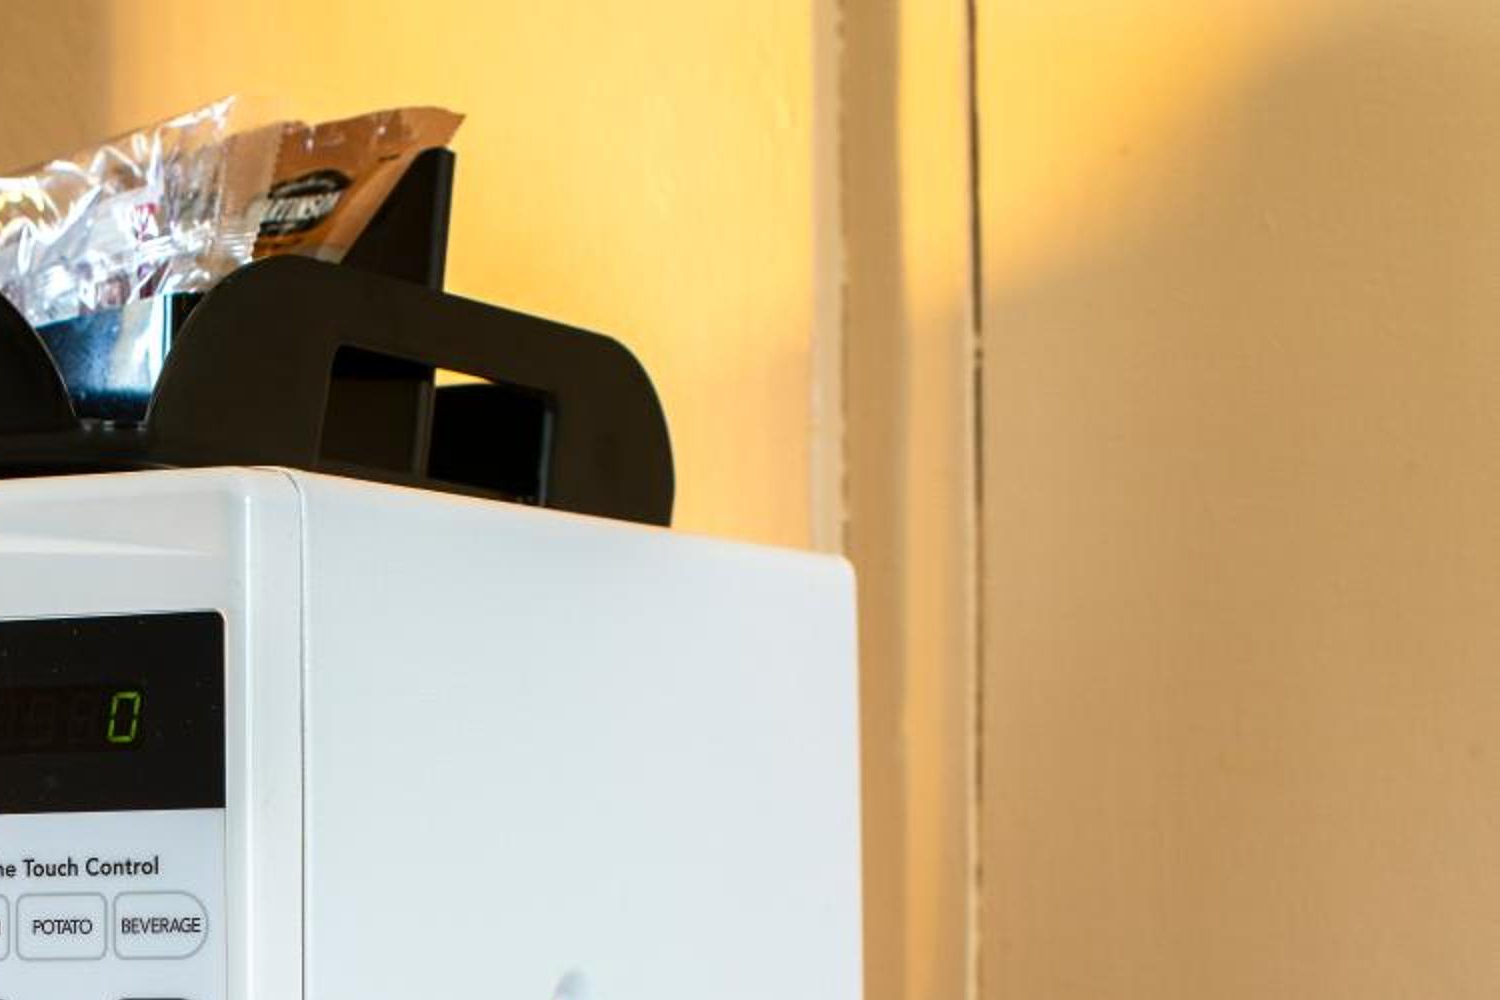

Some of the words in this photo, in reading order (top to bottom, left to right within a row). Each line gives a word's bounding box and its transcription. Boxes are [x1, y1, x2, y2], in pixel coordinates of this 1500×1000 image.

[107, 691, 141, 743] 0
[23, 856, 79, 877] Touch
[85, 855, 159, 876] Control
[32, 918, 93, 935] POTATO
[121, 917, 201, 934] BEVERAGE
